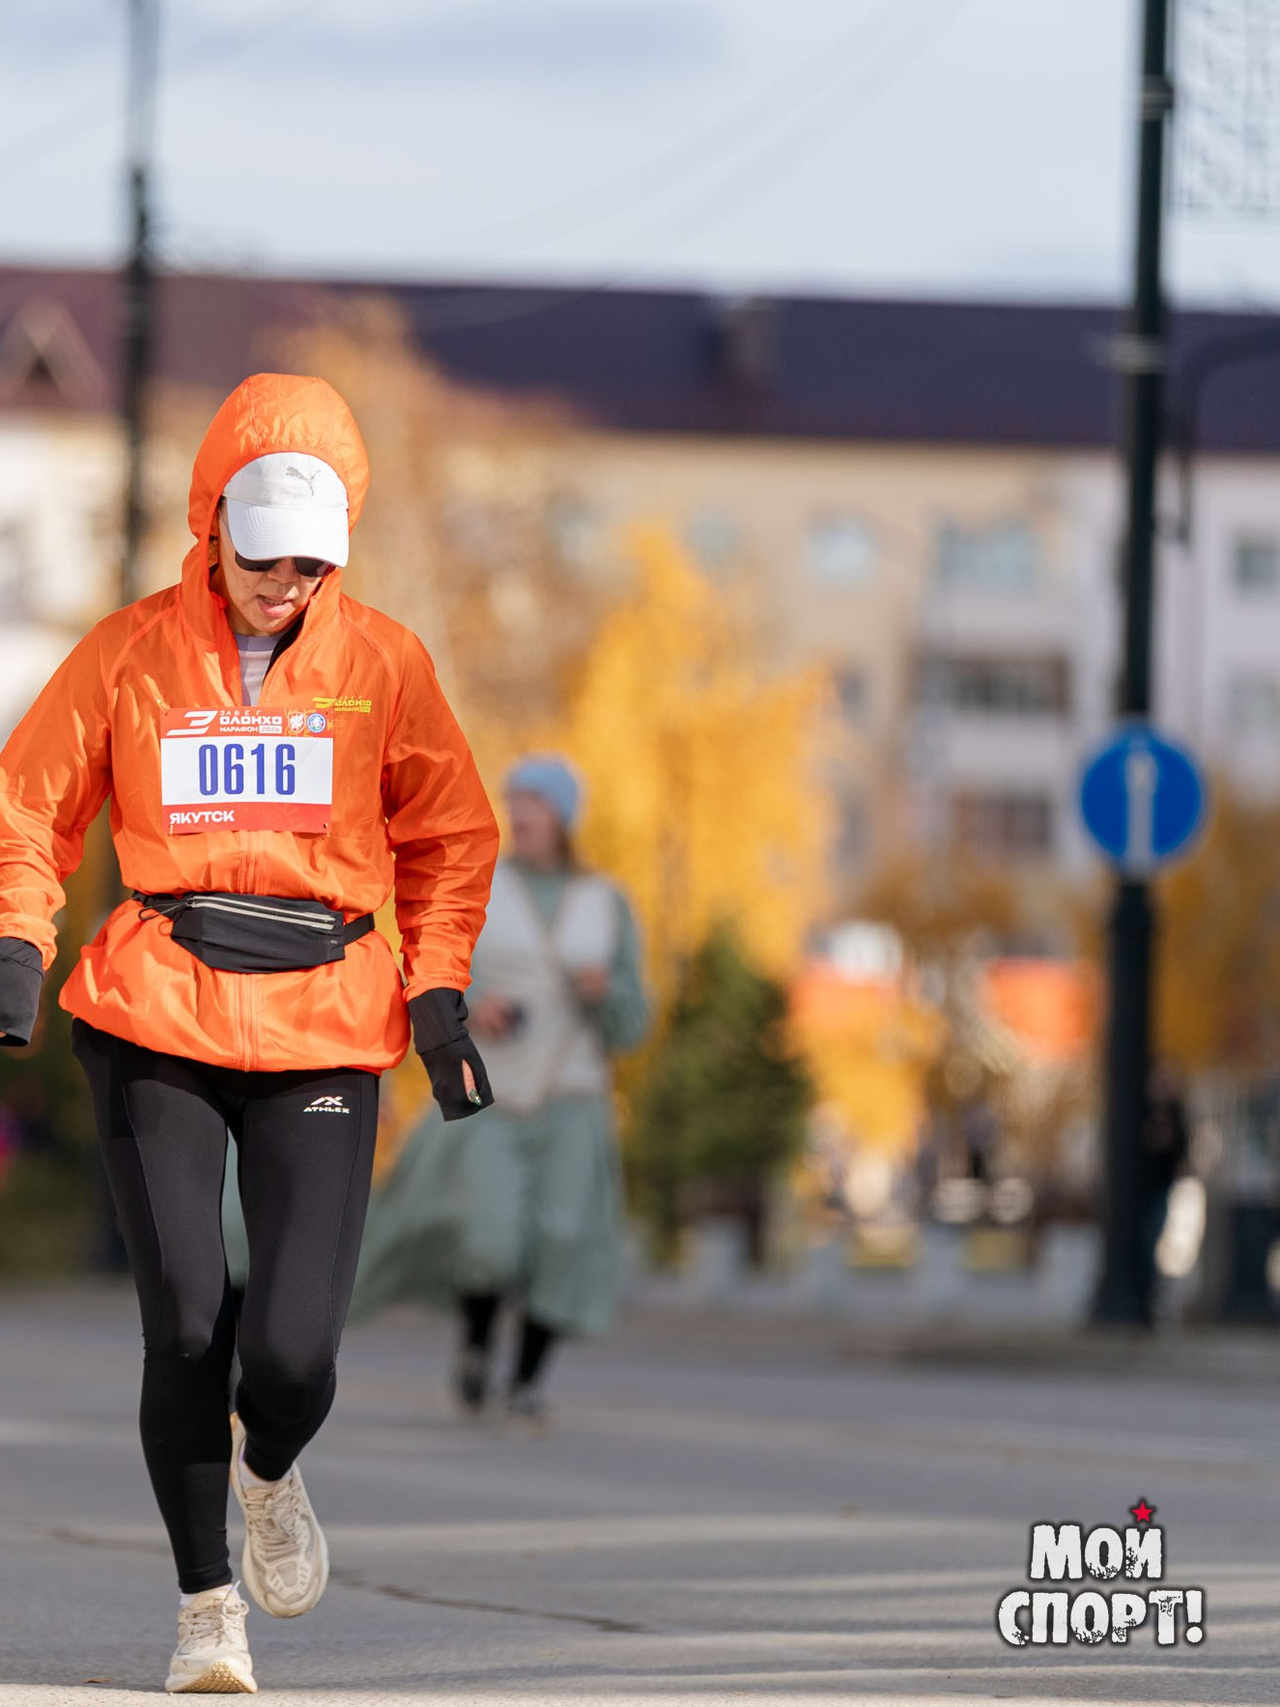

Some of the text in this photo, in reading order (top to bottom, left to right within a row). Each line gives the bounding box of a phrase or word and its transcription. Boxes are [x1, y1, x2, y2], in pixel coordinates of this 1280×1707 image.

[220, 716, 282, 725] ОЛОНХО
[199, 743, 296, 796] 0616
[169, 810, 235, 825] ЯКУТСК
[303, 1106, 350, 1114] ATHLEX
